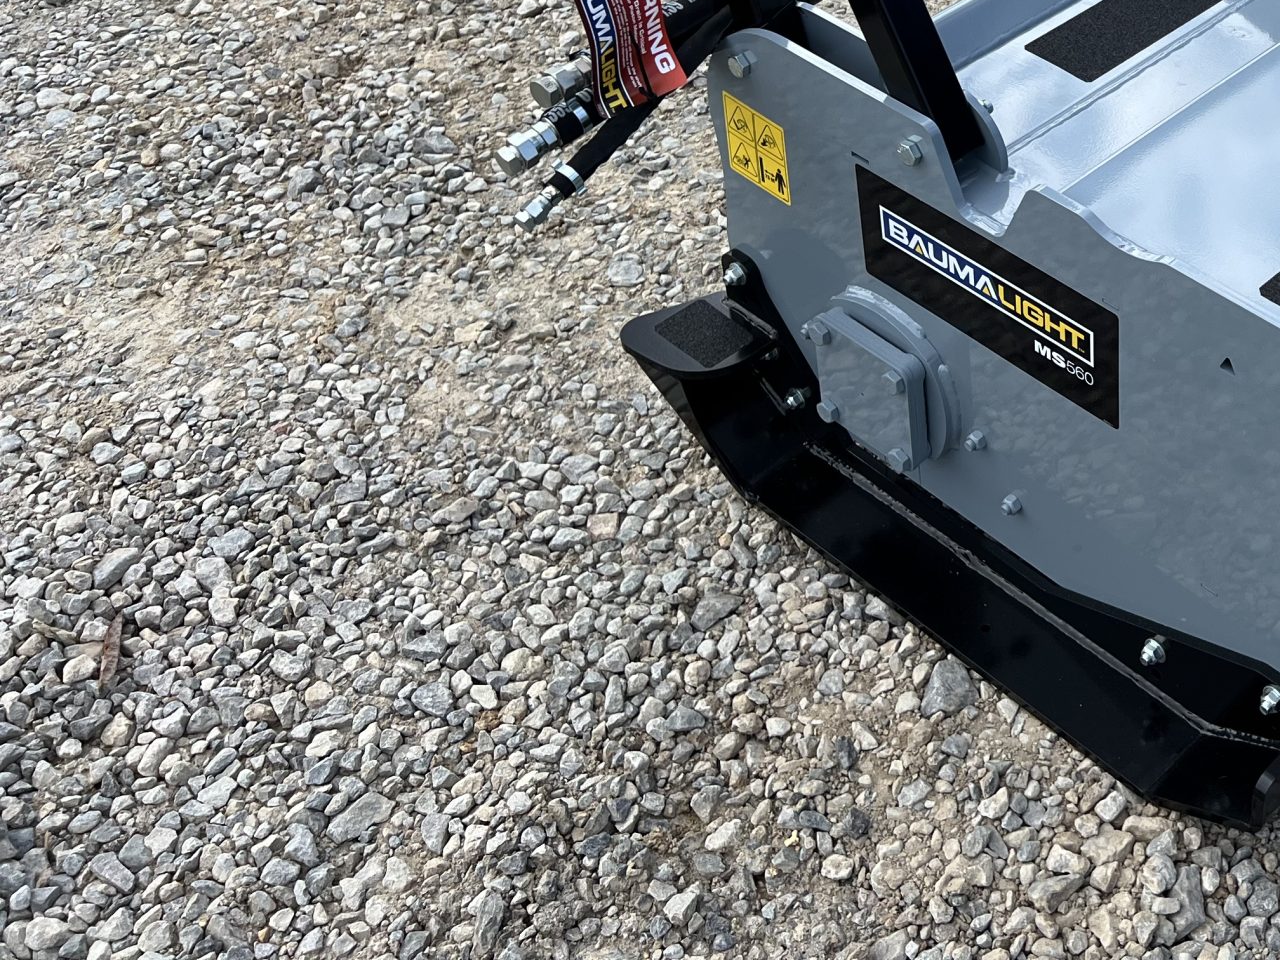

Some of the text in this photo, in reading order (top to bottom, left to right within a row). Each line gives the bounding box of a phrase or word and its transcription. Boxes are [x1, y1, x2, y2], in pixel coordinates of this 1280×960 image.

[633, 0, 642, 22] Drain
[888, 218, 1085, 349] BAUMALIGHT
[1034, 339, 1094, 386] MS560
